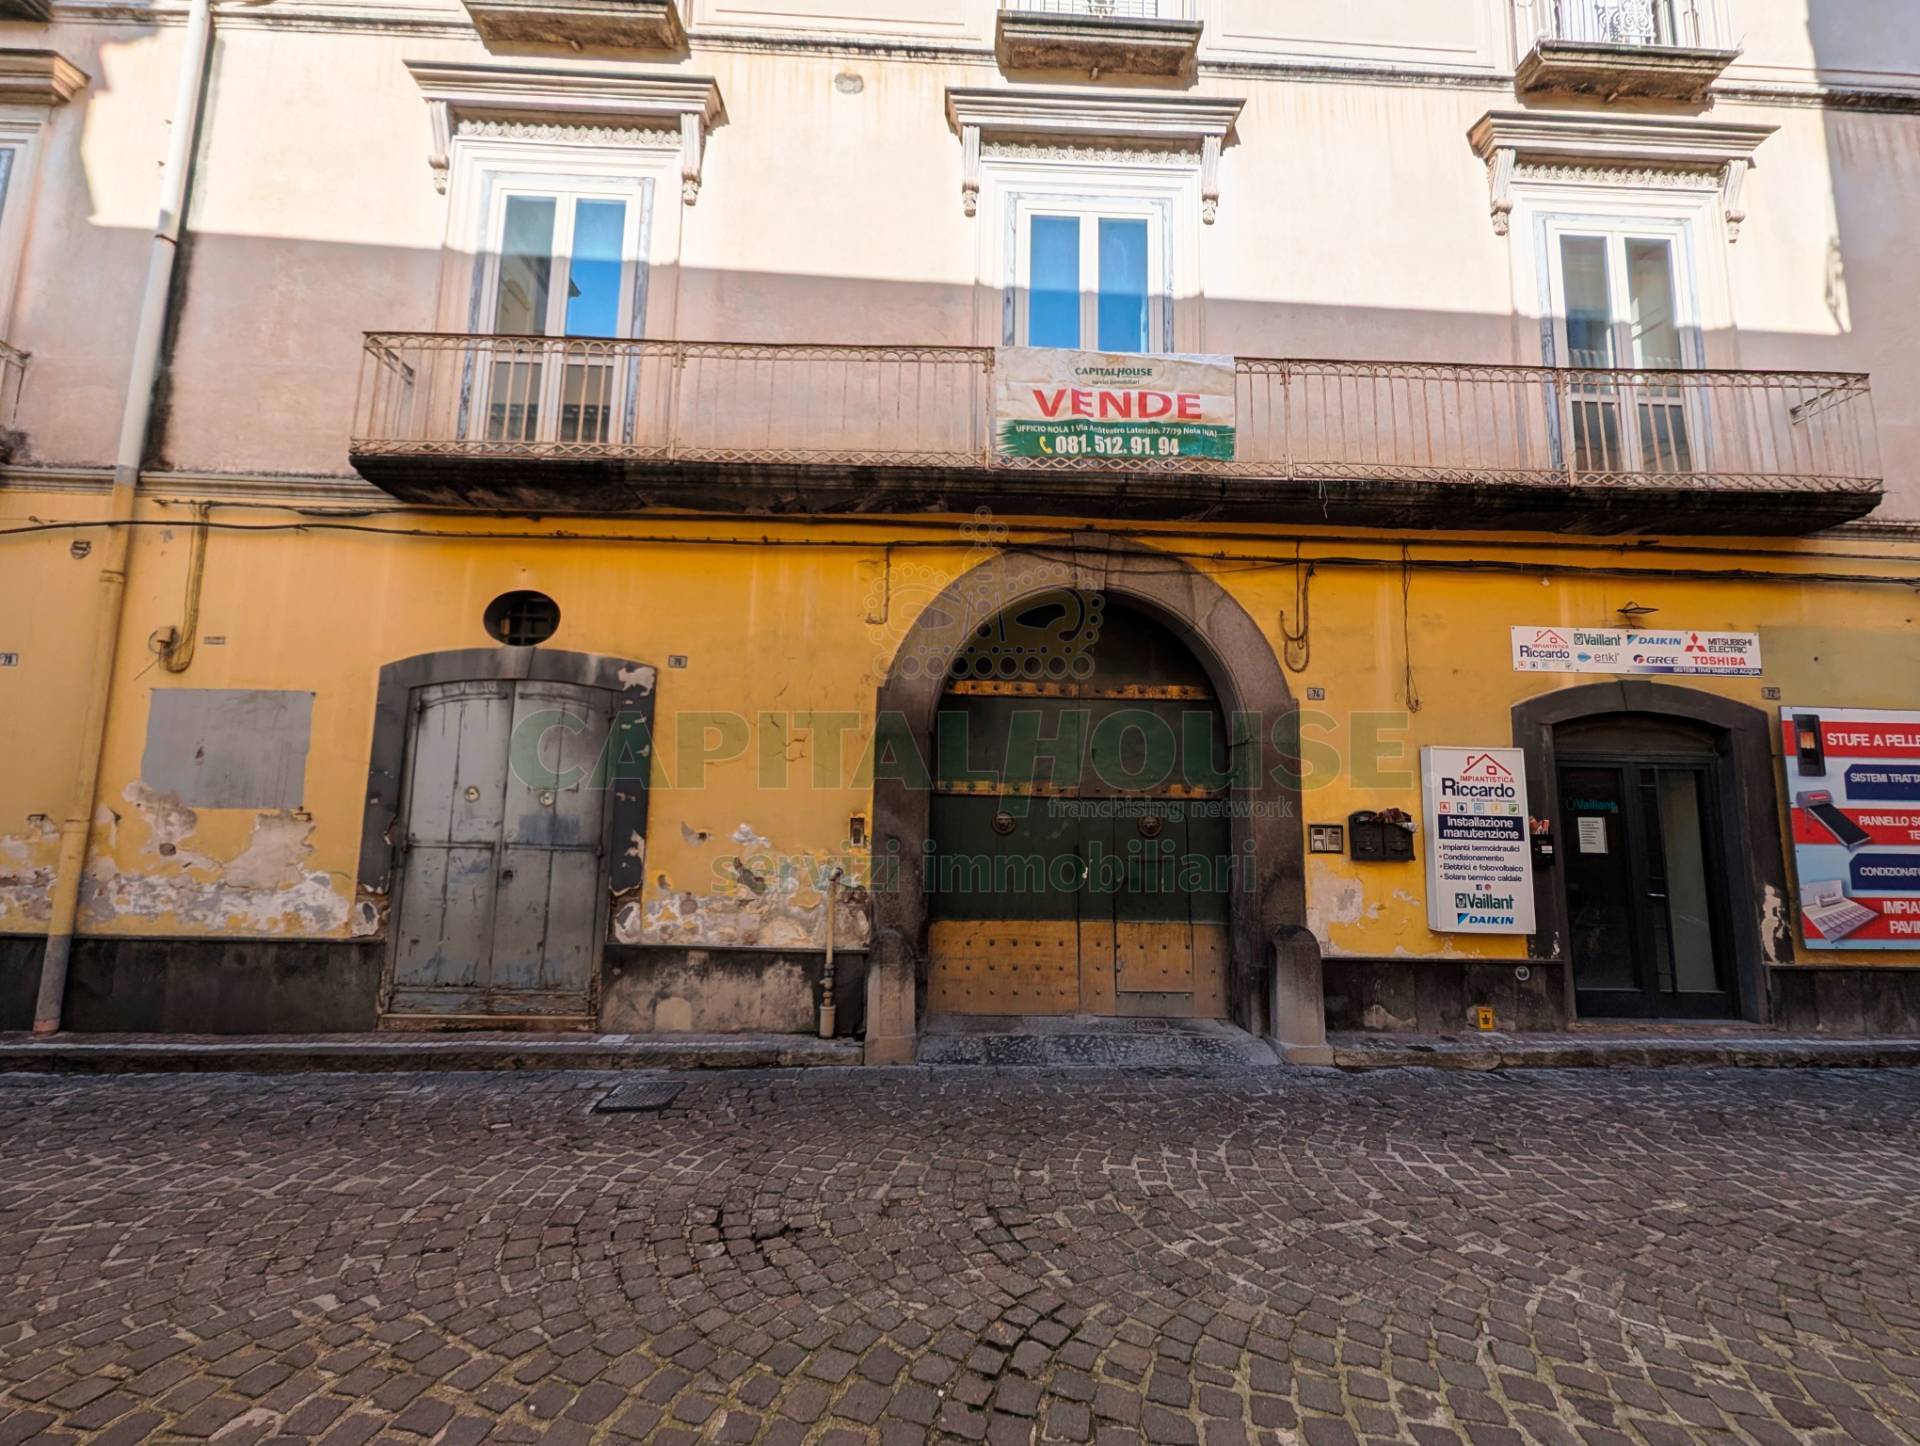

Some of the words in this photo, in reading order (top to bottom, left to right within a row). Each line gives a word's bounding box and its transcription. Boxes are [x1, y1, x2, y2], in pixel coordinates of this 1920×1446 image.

[1075, 367, 1153, 378] CAPITALHOUSE
[1032, 388, 1203, 420] VENDE
[1016, 425, 1047, 433] UFFICIO
[1048, 426, 1069, 434] NOLA
[1076, 423, 1088, 431] Via
[1583, 633, 1621, 646] Vaillant
[1638, 637, 1682, 645] DAIKIN
[1707, 638, 1753, 647] MITSUBISHI
[1520, 645, 1570, 659] Riccardo
[1708, 646, 1748, 654] ELECTRIC
[1646, 655, 1679, 664] GREE
[1692, 656, 1747, 666] TOSHIBA
[1827, 733, 1871, 746] STUFE
[1873, 734, 1884, 747] A
[1460, 775, 1514, 783] IMPIANTISTICA
[1850, 773, 1888, 783] SISTEMI
[1441, 777, 1515, 798] Riccardo
[1576, 799, 1617, 810] Vaillant
[1447, 816, 1514, 828] Installazione
[1859, 816, 1909, 826] PANNELLO
[1443, 828, 1519, 839] manutenzione
[1443, 854, 1505, 862] Condizionamento
[1479, 864, 1524, 872] fotovoltaico
[1497, 874, 1522, 882] caldaie
[1466, 893, 1514, 909] Vaillant
[1469, 916, 1514, 924] DAIKIN
